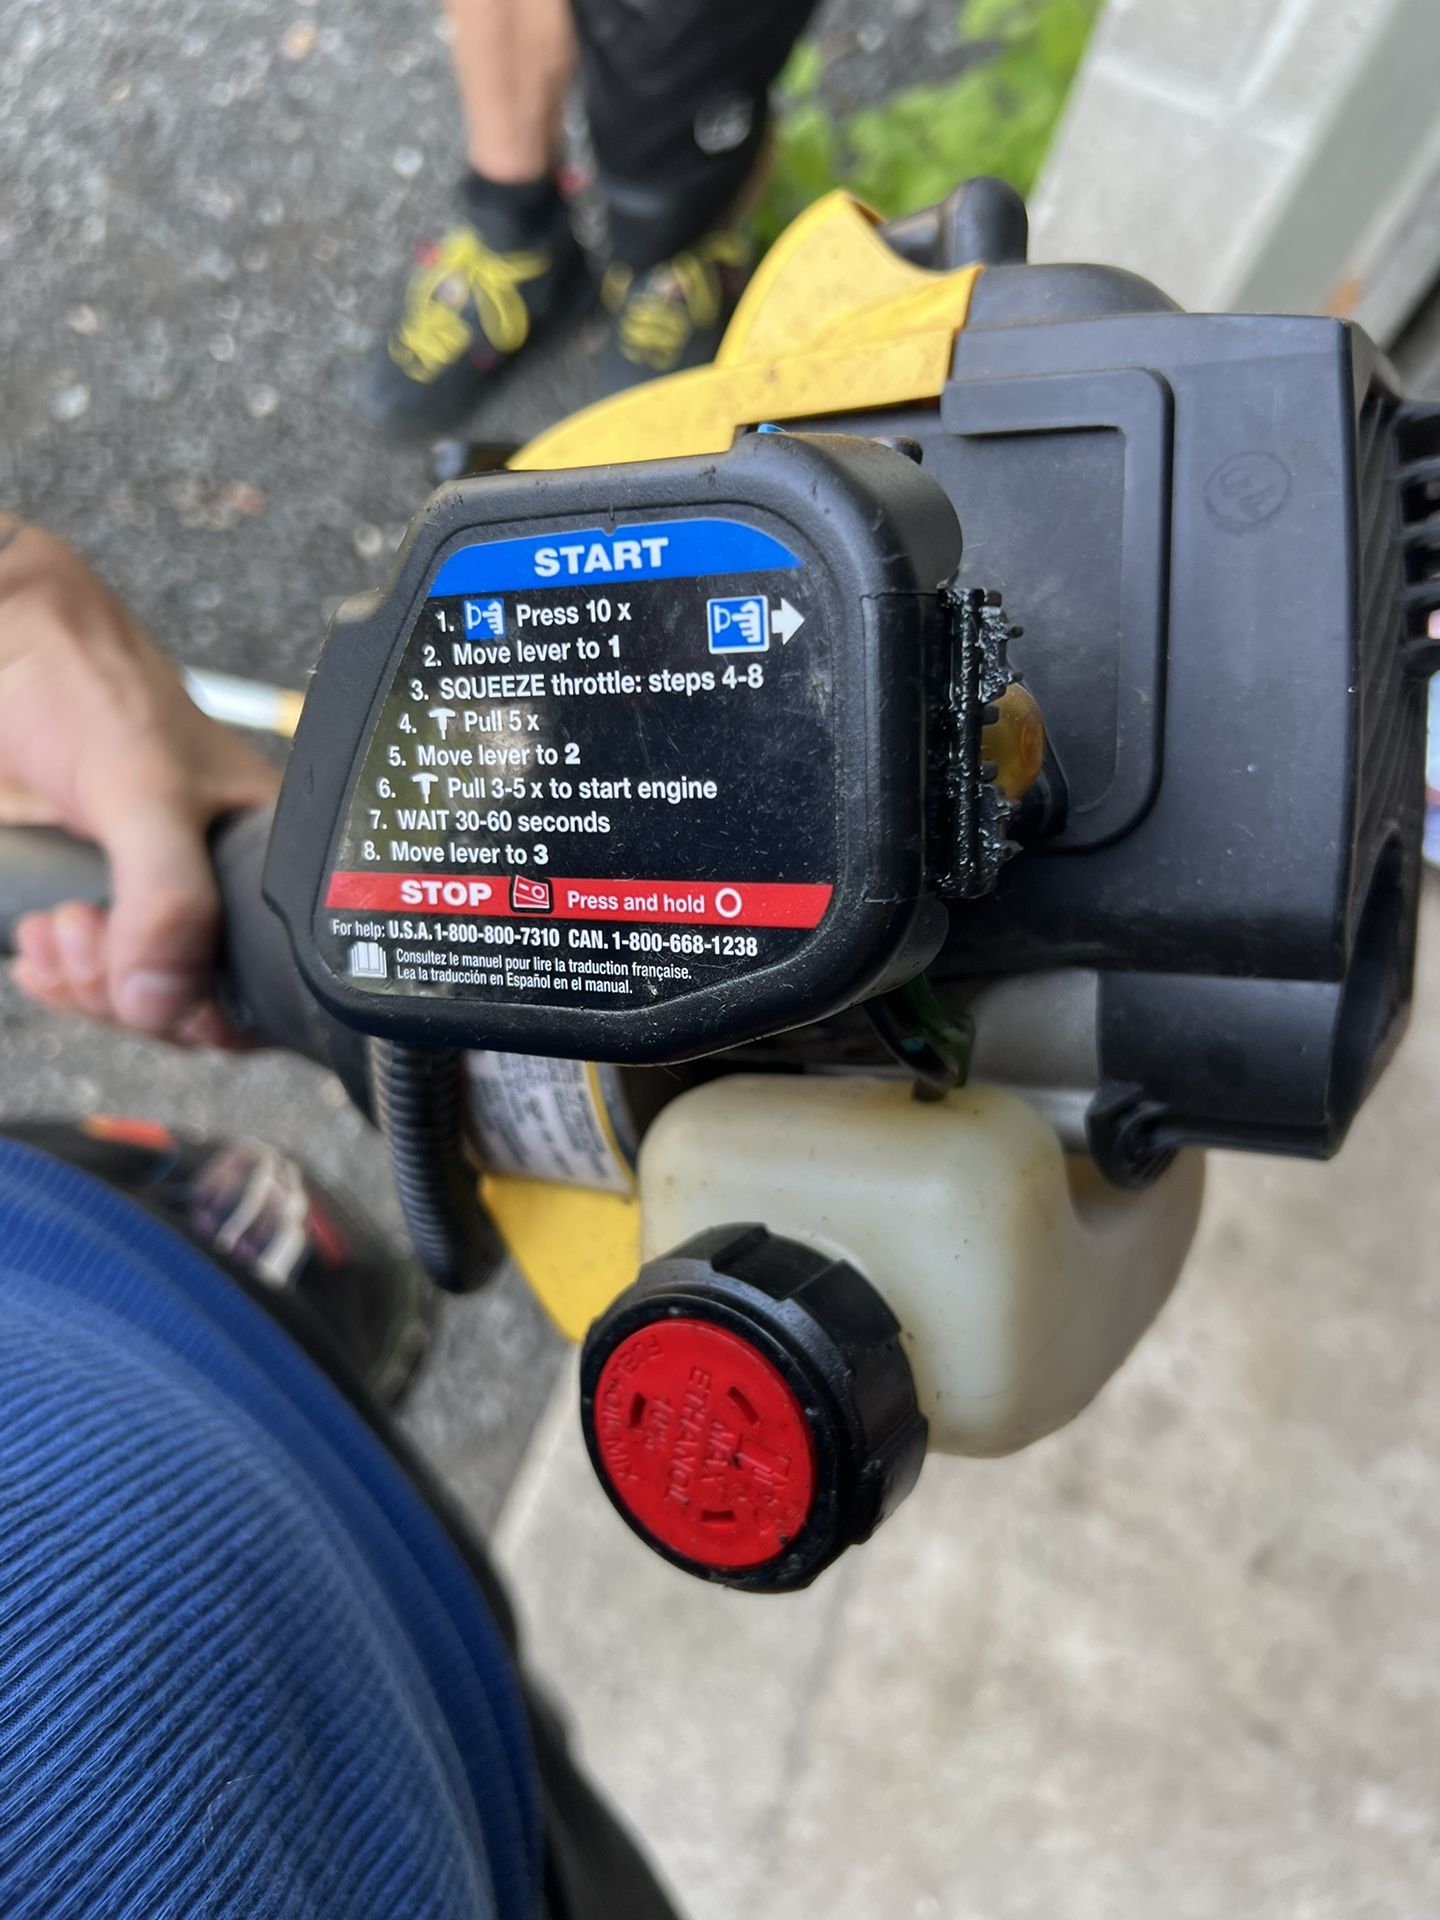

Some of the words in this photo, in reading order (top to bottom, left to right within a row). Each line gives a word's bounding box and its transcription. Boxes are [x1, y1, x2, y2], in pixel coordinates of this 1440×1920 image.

[533, 538, 669, 577] START
[436, 610, 455, 633] 1.
[516, 602, 579, 628] Press
[585, 600, 610, 623] 10
[617, 601, 632, 622] x
[423, 646, 442, 667] 2.
[453, 642, 512, 665] Move
[517, 638, 571, 663] lever
[575, 638, 601, 660] to
[608, 635, 621, 658] 1
[411, 680, 429, 701] 3.
[440, 675, 546, 700] SQUEEZE
[551, 670, 642, 696] throttle:
[648, 669, 715, 696] steps
[721, 664, 764, 690] 4-8
[399, 713, 417, 734] 4.
[464, 711, 504, 733] Pull
[509, 711, 521, 731] 5
[527, 716, 540, 732] x
[389, 745, 407, 766] 5.
[417, 745, 473, 767] Move
[477, 744, 532, 766] lever
[535, 745, 559, 765] to
[565, 743, 580, 765] 2
[378, 778, 396, 799] 6.
[448, 778, 487, 799] Pull
[491, 778, 526, 799] 3-5
[530, 782, 544, 799] x
[548, 779, 574, 799] to
[578, 777, 636, 800] start
[638, 775, 718, 806] engine
[370, 809, 387, 829] 7.
[398, 810, 450, 831] WAIT
[456, 811, 513, 832] 30-60
[517, 810, 611, 833] seconds
[364, 841, 381, 862] 8.
[391, 841, 445, 862] Move
[449, 843, 501, 864] lever
[505, 845, 528, 865] to
[533, 845, 548, 865] 3
[401, 880, 492, 906] STOP
[567, 890, 619, 911] Press
[623, 892, 660, 912] and
[663, 893, 705, 914] hold
[333, 919, 352, 936] For
[357, 920, 386, 940] help:
[389, 922, 433, 941] U.S.A.
[433, 925, 560, 947] 1-800-800-7310
[569, 932, 609, 951] CAN.
[612, 933, 758, 957] 1-800-668-1238
[396, 949, 448, 966] Consultez
[450, 952, 460, 966] le
[463, 953, 503, 967] manuel
[506, 956, 531, 972] pour
[533, 956, 552, 971] lire
[555, 957, 566, 972] la
[568, 959, 629, 975] traduction
[631, 961, 692, 981] française.
[397, 966, 415, 979] Lea
[418, 967, 429, 980] la
[430, 968, 488, 984] traducción
[490, 974, 504, 985] en
[506, 973, 551, 992] Español
[554, 978, 568, 989] en
[570, 977, 581, 990] el
[583, 979, 633, 995] manual.
[664, 1365, 712, 1506] ETHANOL
